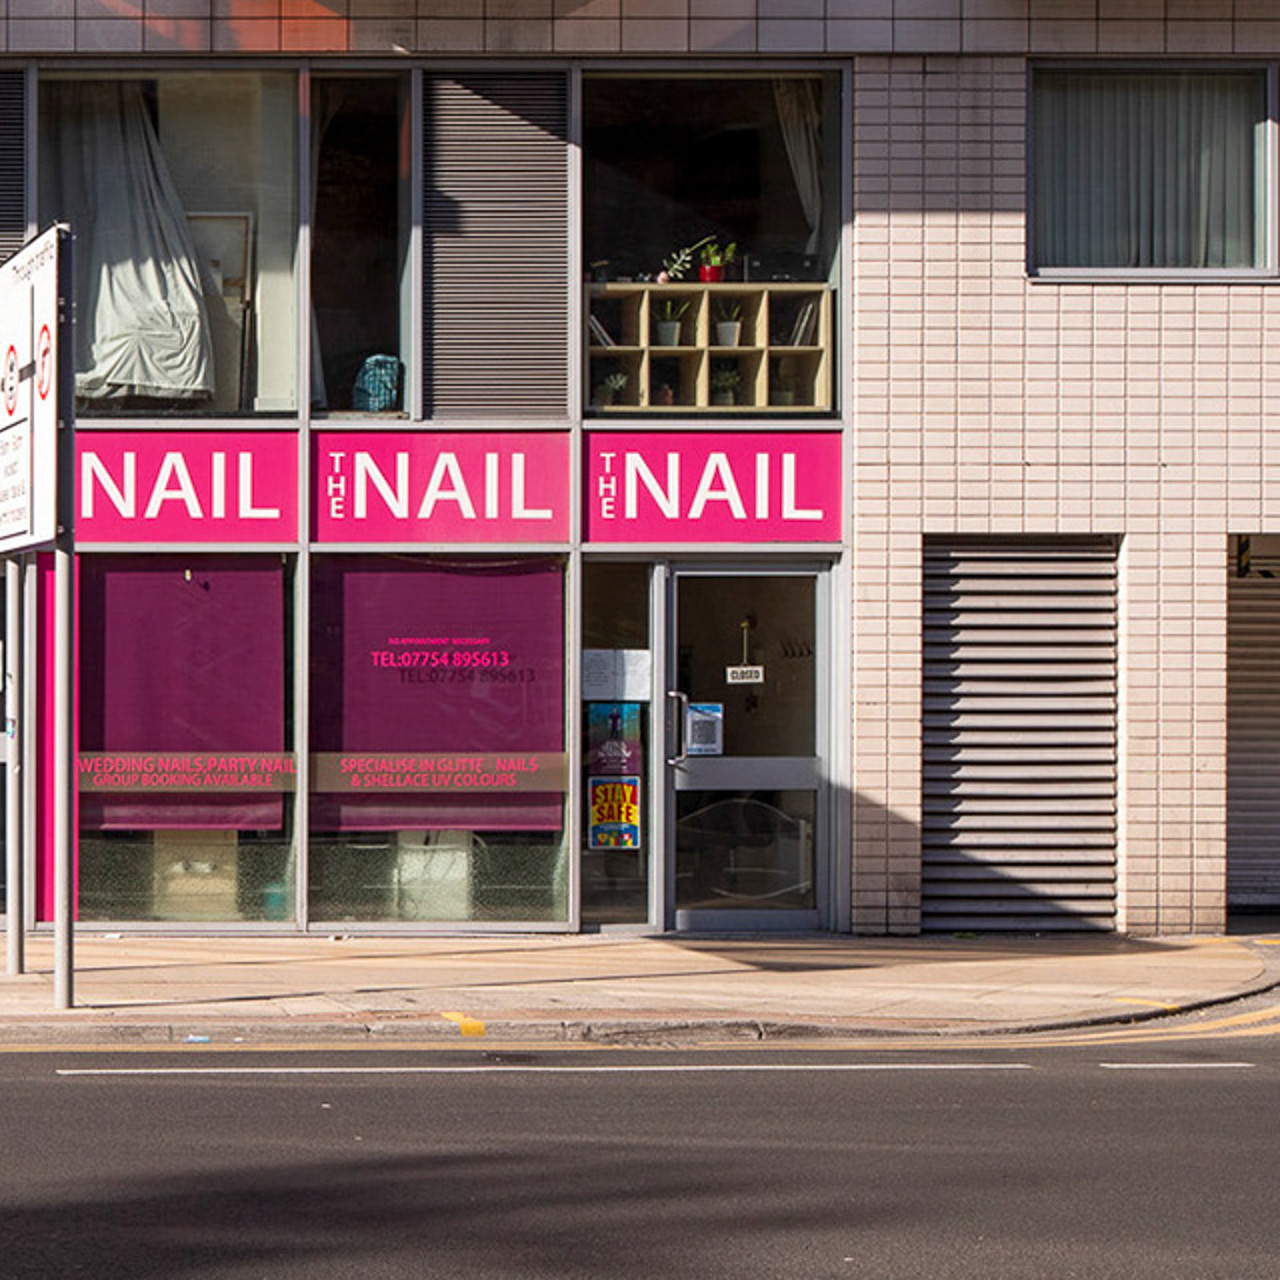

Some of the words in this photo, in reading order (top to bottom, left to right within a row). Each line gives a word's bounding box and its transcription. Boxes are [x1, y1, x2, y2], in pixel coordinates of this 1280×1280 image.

[80, 452, 281, 519] NAIL
[328, 453, 346, 519] THE
[354, 452, 553, 519] NAIL
[598, 453, 616, 519] THE
[624, 452, 823, 519] NAIL
[371, 651, 450, 667] TEL:07754
[452, 651, 509, 667] 895613
[730, 669, 760, 681] CLOSED
[79, 757, 155, 773] WEDDING
[260, 757, 297, 773] NAIL
[340, 758, 418, 773] SPECIALISE
[419, 758, 435, 773] IN
[495, 757, 539, 772] NAILS
[93, 773, 138, 787] GROUP
[141, 773, 201, 787] BOOKING
[203, 773, 273, 787] AVAILABLE
[350, 773, 360, 787] &
[363, 773, 430, 787] SHELLACE
[432, 773, 450, 787] UV
[453, 773, 517, 787] COLOURS
[595, 784, 634, 804] STAY
[596, 803, 634, 823] SAFE
